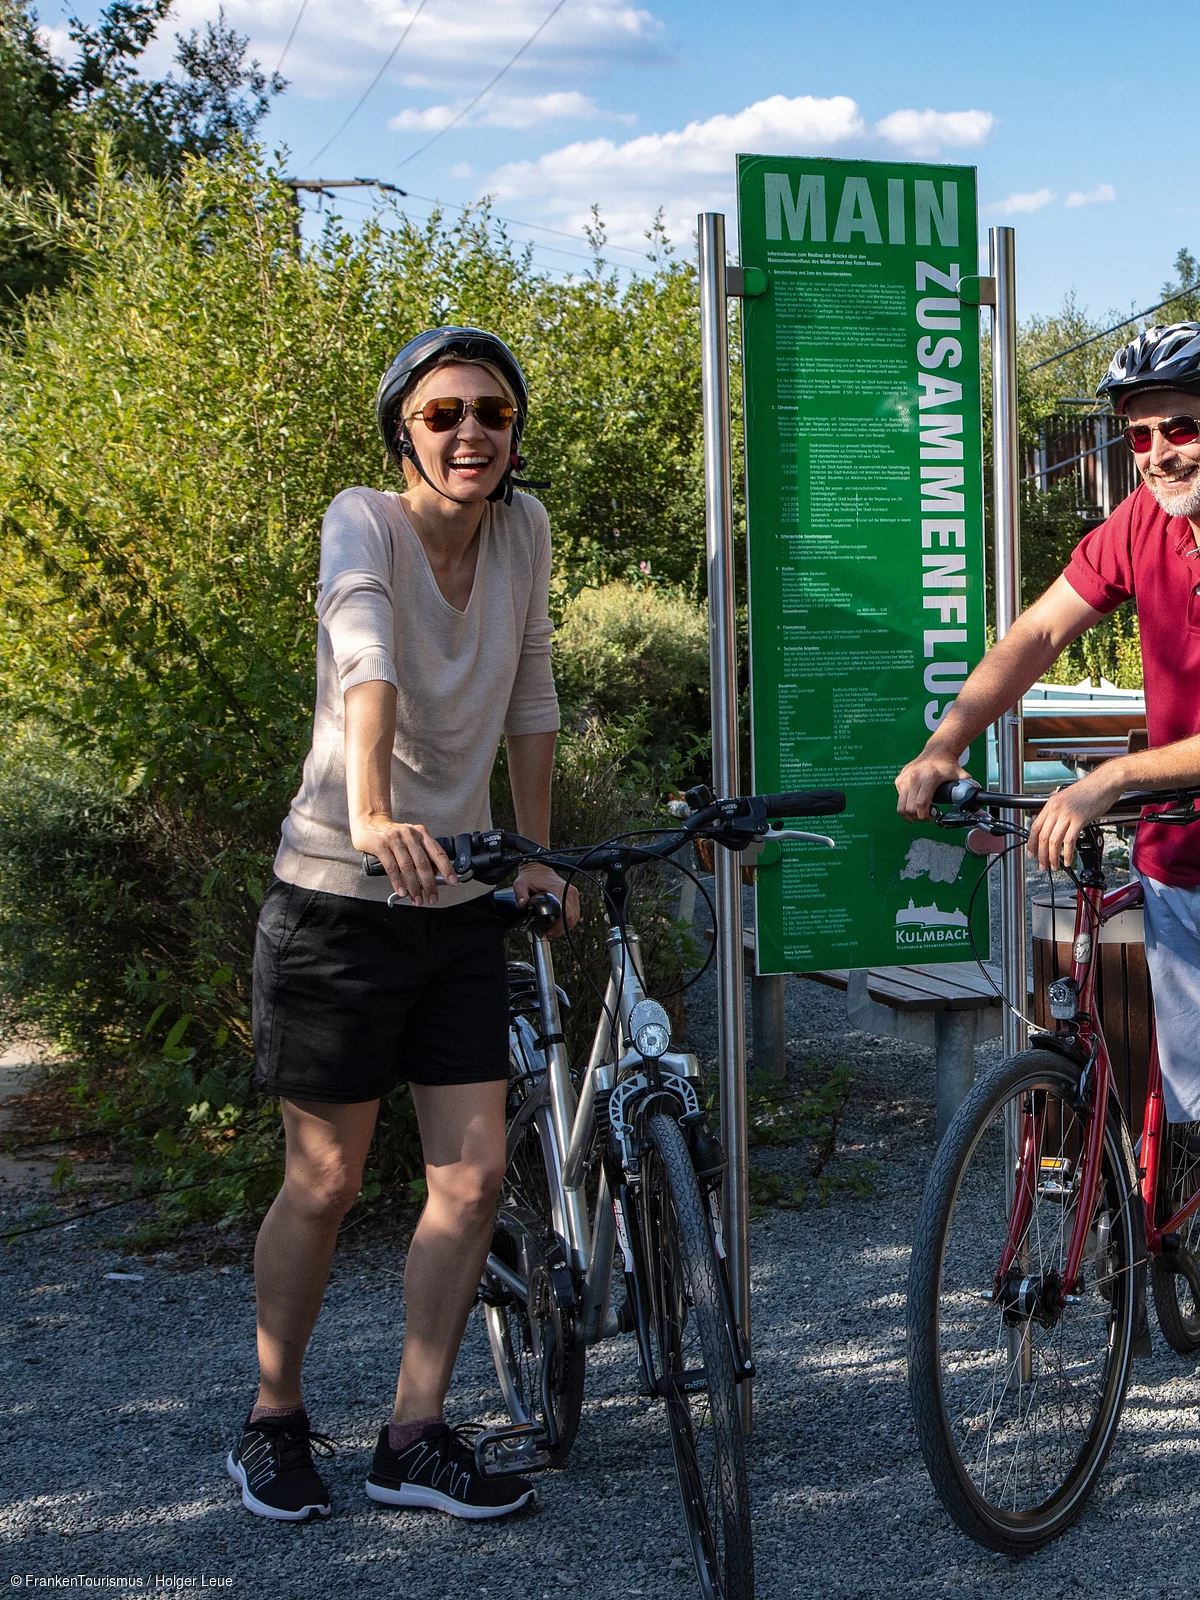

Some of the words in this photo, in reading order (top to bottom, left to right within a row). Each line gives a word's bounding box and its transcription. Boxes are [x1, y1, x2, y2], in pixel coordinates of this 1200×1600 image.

[764, 172, 959, 247] MAIN
[915, 260, 971, 768] ZUSAMMENFLUS
[896, 929, 969, 943] KULMBACH
